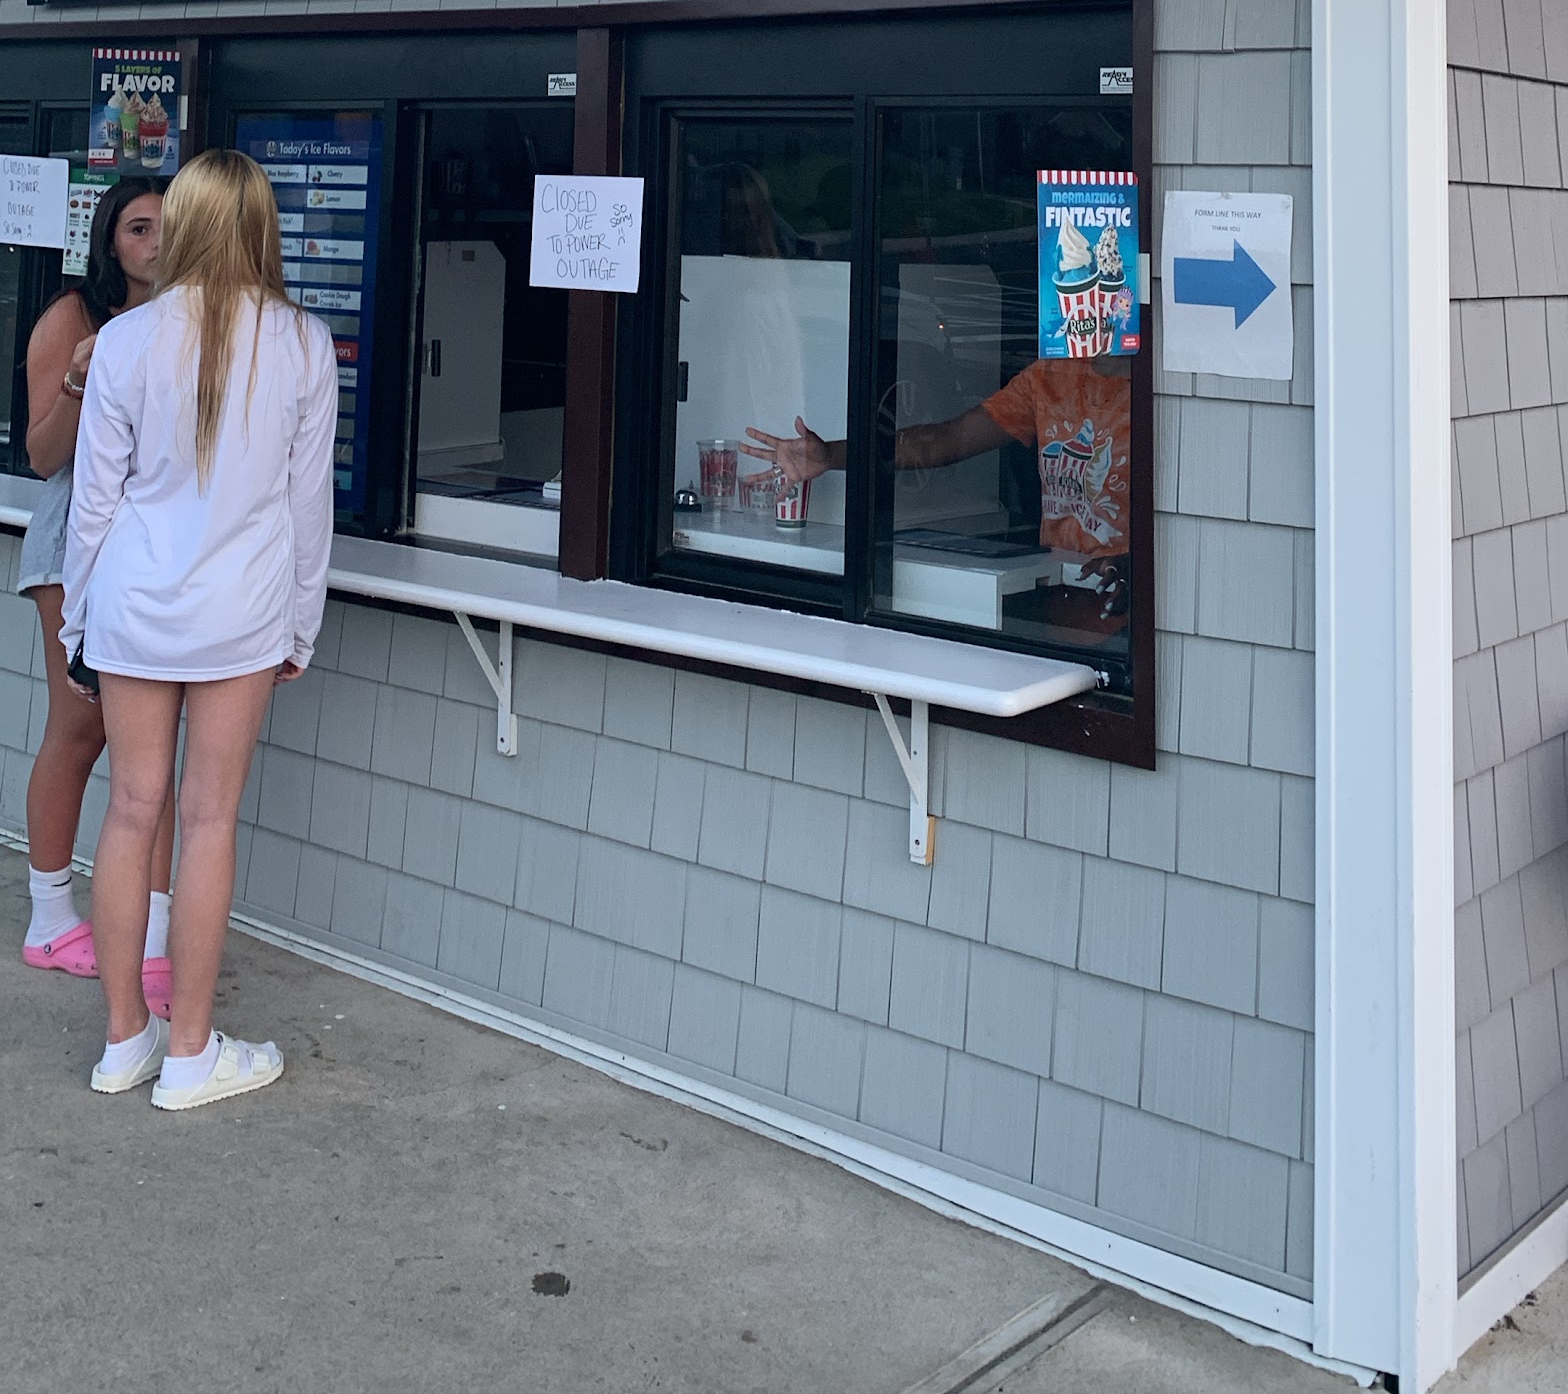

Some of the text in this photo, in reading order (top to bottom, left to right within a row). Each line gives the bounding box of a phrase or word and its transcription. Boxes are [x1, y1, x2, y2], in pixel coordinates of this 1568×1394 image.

[121, 65, 151, 73] LAYERS
[100, 73, 175, 93] FLAVOR
[279, 143, 351, 157] Today's Ice Flavors
[327, 169, 343, 179] Cherry
[1052, 191, 1125, 204] MERMAIZING &
[8, 202, 35, 216] OUTAGE
[1195, 209, 1214, 217] FORM
[1215, 210, 1229, 218] LINE
[565, 214, 599, 233] DUE
[1045, 206, 1131, 228] FINTASTIC
[547, 233, 611, 256] TO POWER
[556, 258, 620, 281] OUTAGE
[320, 290, 335, 298] Cookie
[1070, 318, 1095, 334] Rita's
